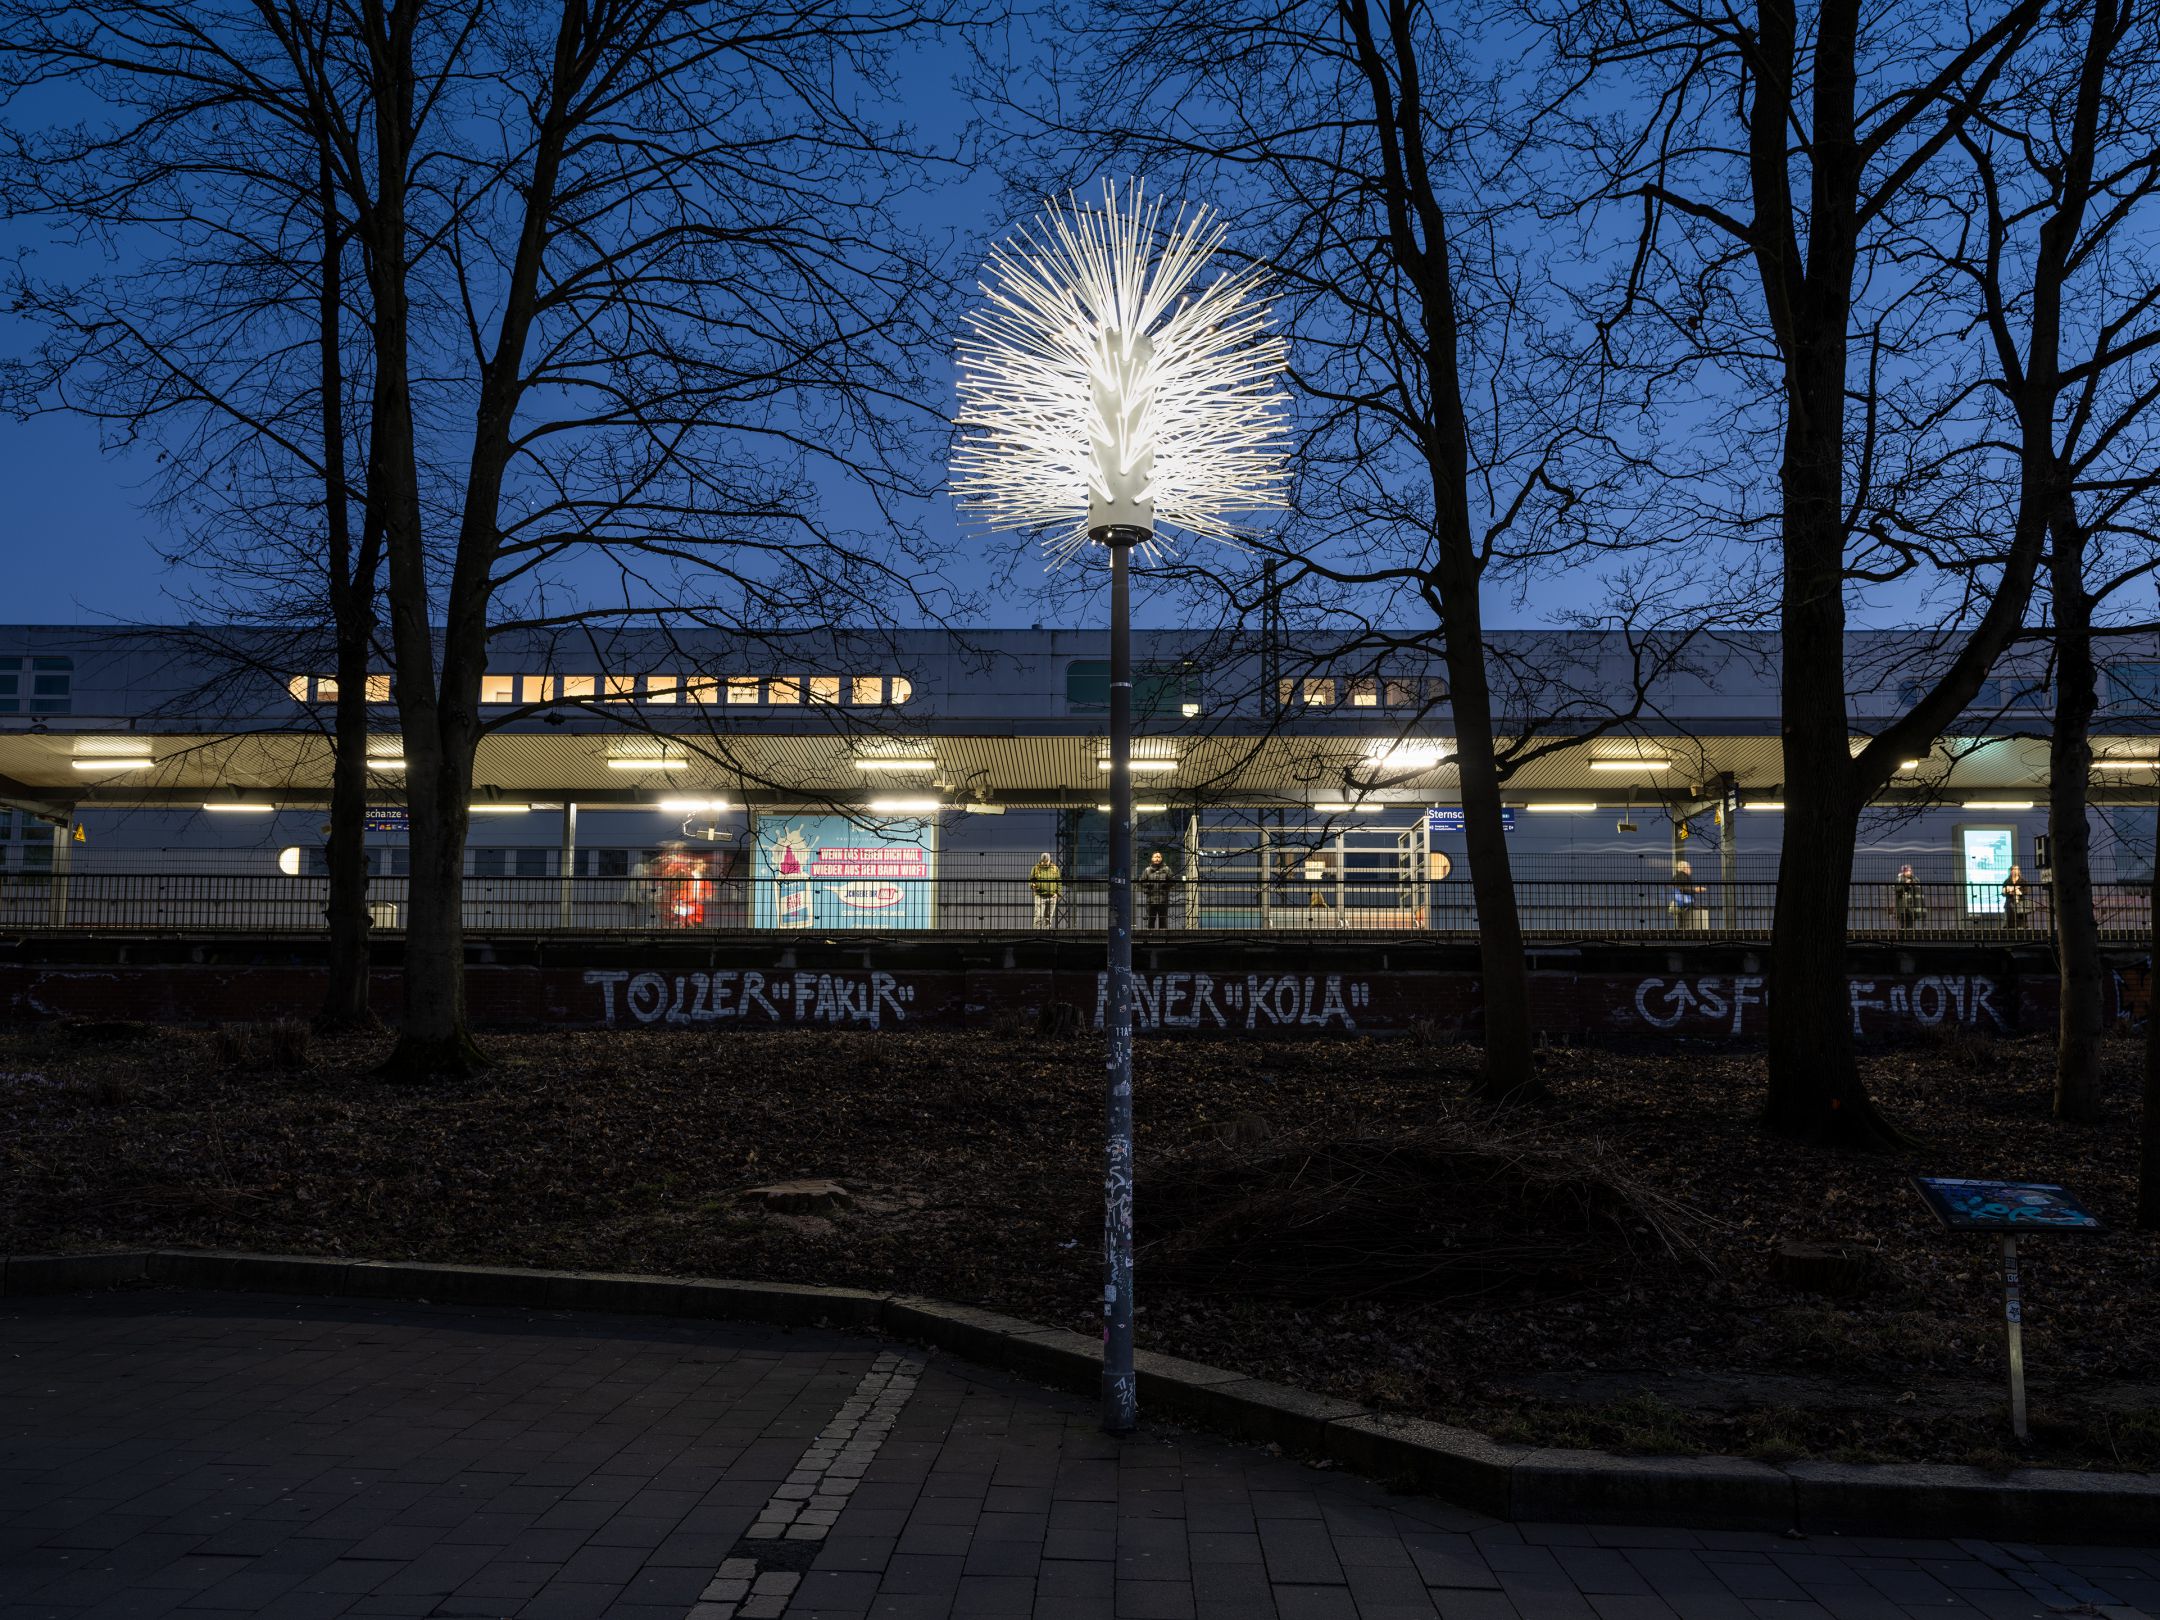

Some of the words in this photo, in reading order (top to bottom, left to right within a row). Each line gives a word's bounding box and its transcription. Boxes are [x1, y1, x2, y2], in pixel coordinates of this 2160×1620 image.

[365, 809, 401, 818] schanze
[820, 848, 843, 860] WENN
[844, 848, 858, 860] DAS
[860, 848, 883, 860] LEBEN
[884, 848, 902, 860] DICH
[903, 849, 919, 860] MAL
[813, 864, 843, 876] WIEDER
[844, 864, 859, 876] AUS
[861, 864, 876, 876] DER
[877, 865, 899, 876] BAHN
[900, 865, 926, 876] WIRFT
